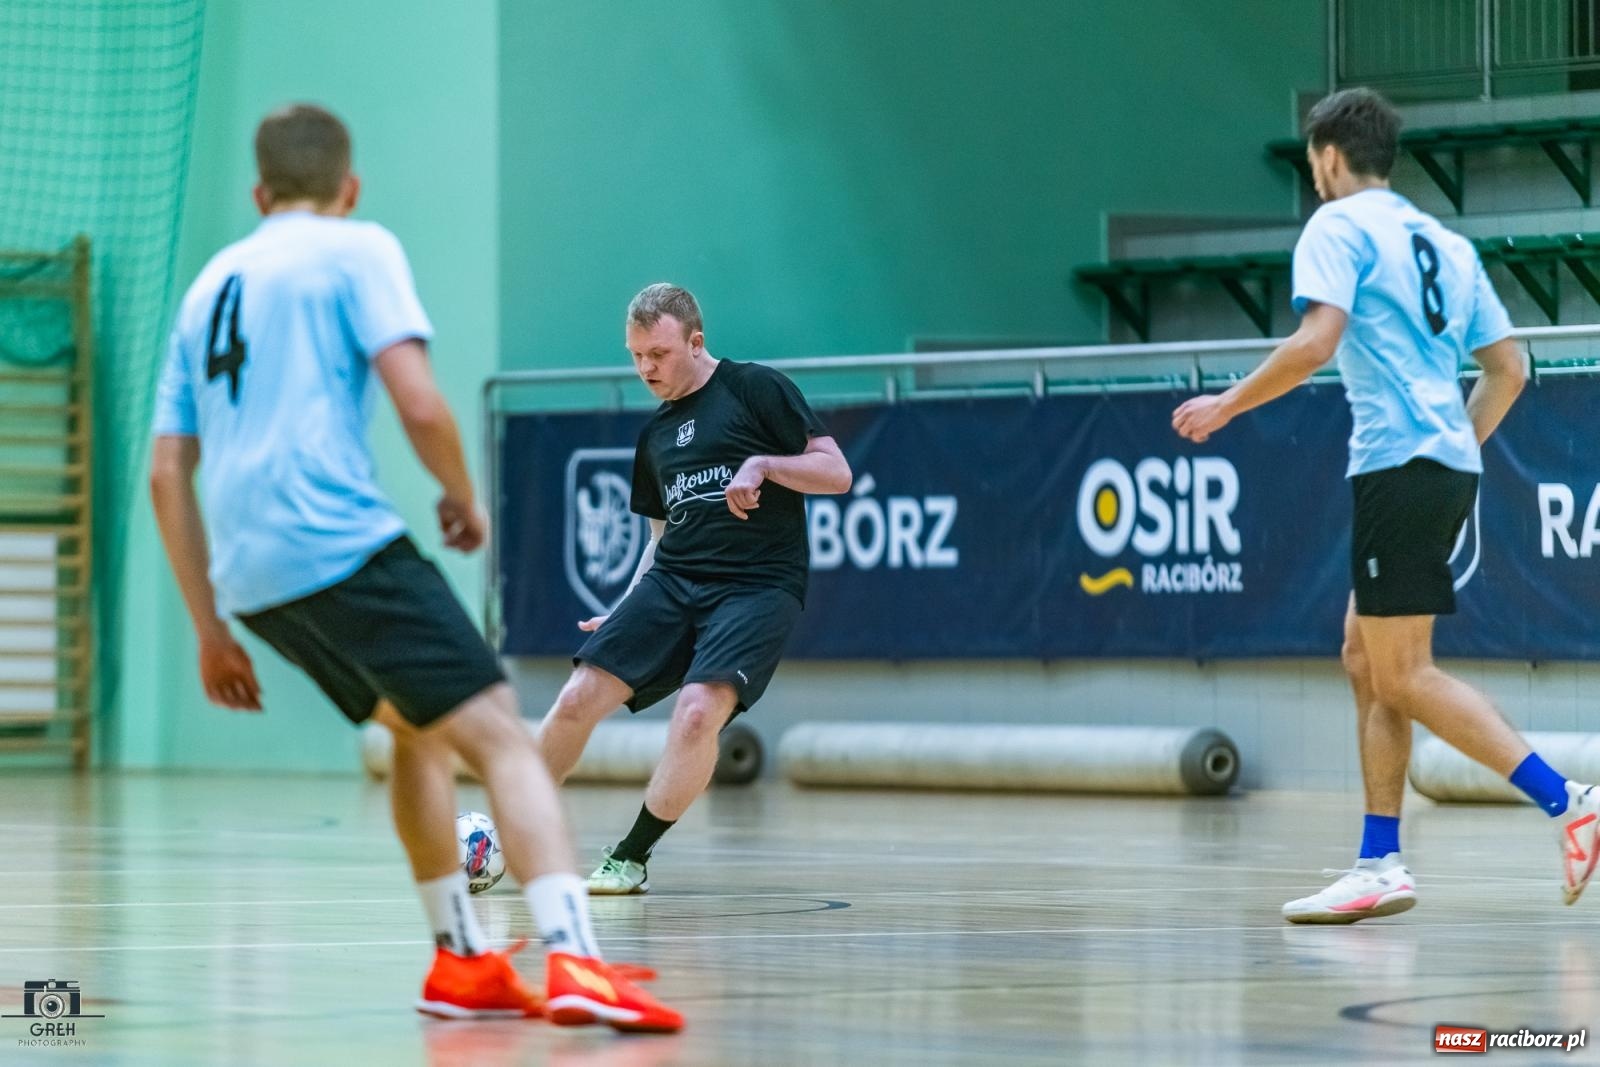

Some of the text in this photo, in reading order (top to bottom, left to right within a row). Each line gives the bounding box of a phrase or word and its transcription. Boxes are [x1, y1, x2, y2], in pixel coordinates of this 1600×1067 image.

[1411, 232, 1449, 337] 8
[206, 274, 247, 406] 4
[807, 473, 960, 571] BÓRZ
[1141, 554, 1243, 594] RACIBÓRZ
